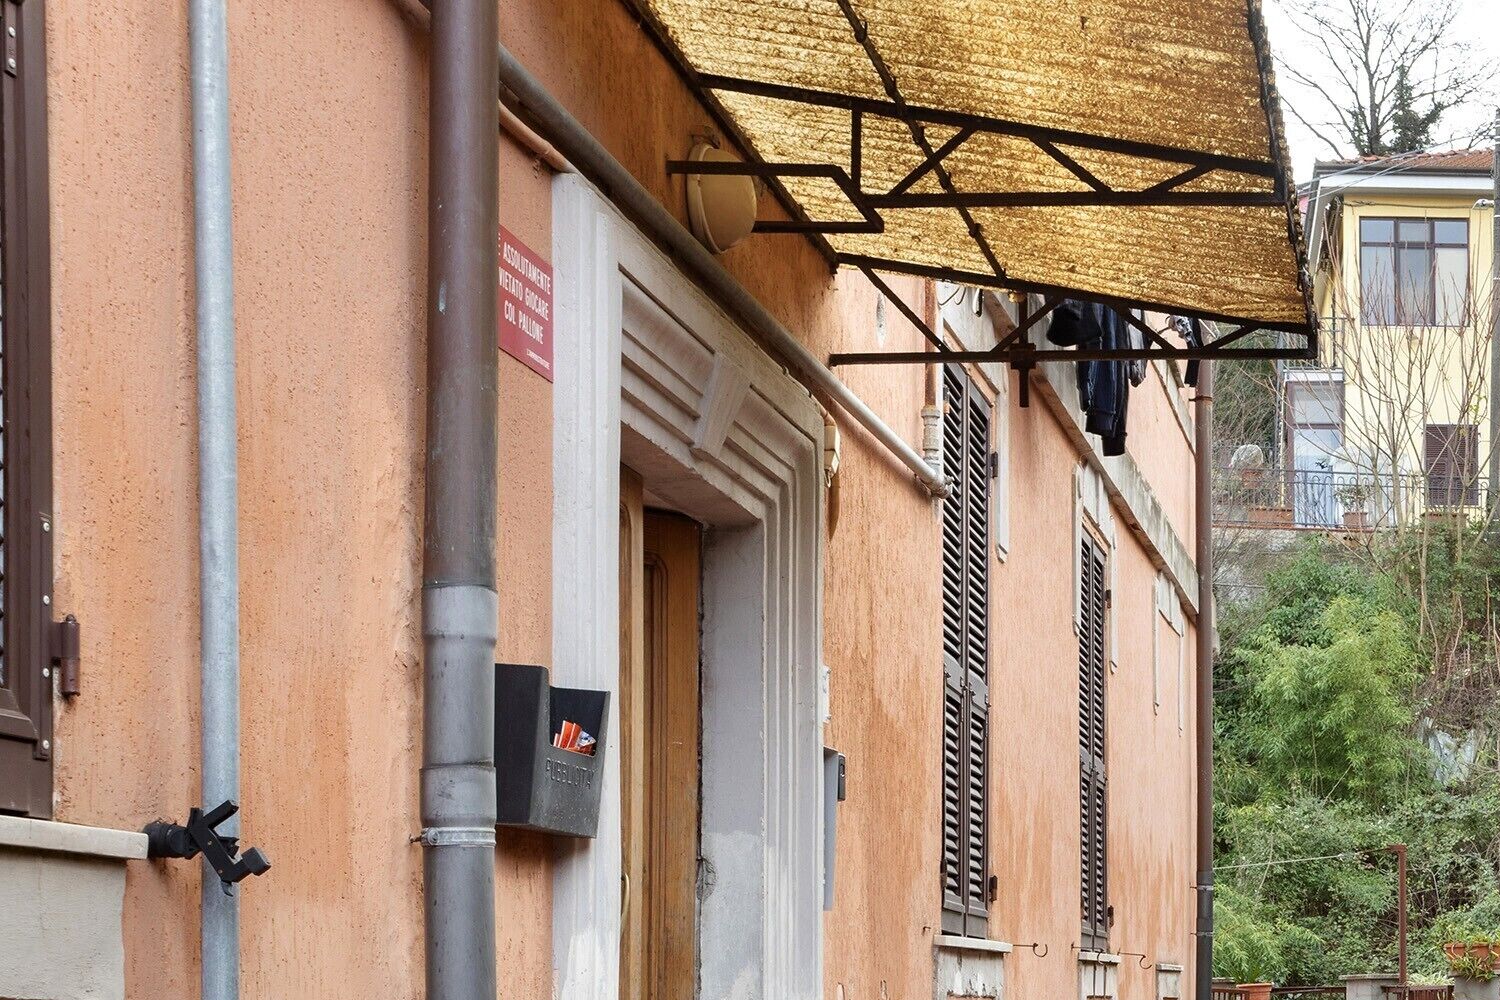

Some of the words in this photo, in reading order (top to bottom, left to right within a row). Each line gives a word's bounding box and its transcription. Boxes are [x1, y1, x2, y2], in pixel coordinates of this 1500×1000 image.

[498, 267, 523, 301] VIETATO
[525, 287, 549, 321] GIOCARE
[503, 241, 551, 295] ASSOLUTAMENTE
[504, 299, 516, 325] COL
[518, 310, 544, 345] PALLONE
